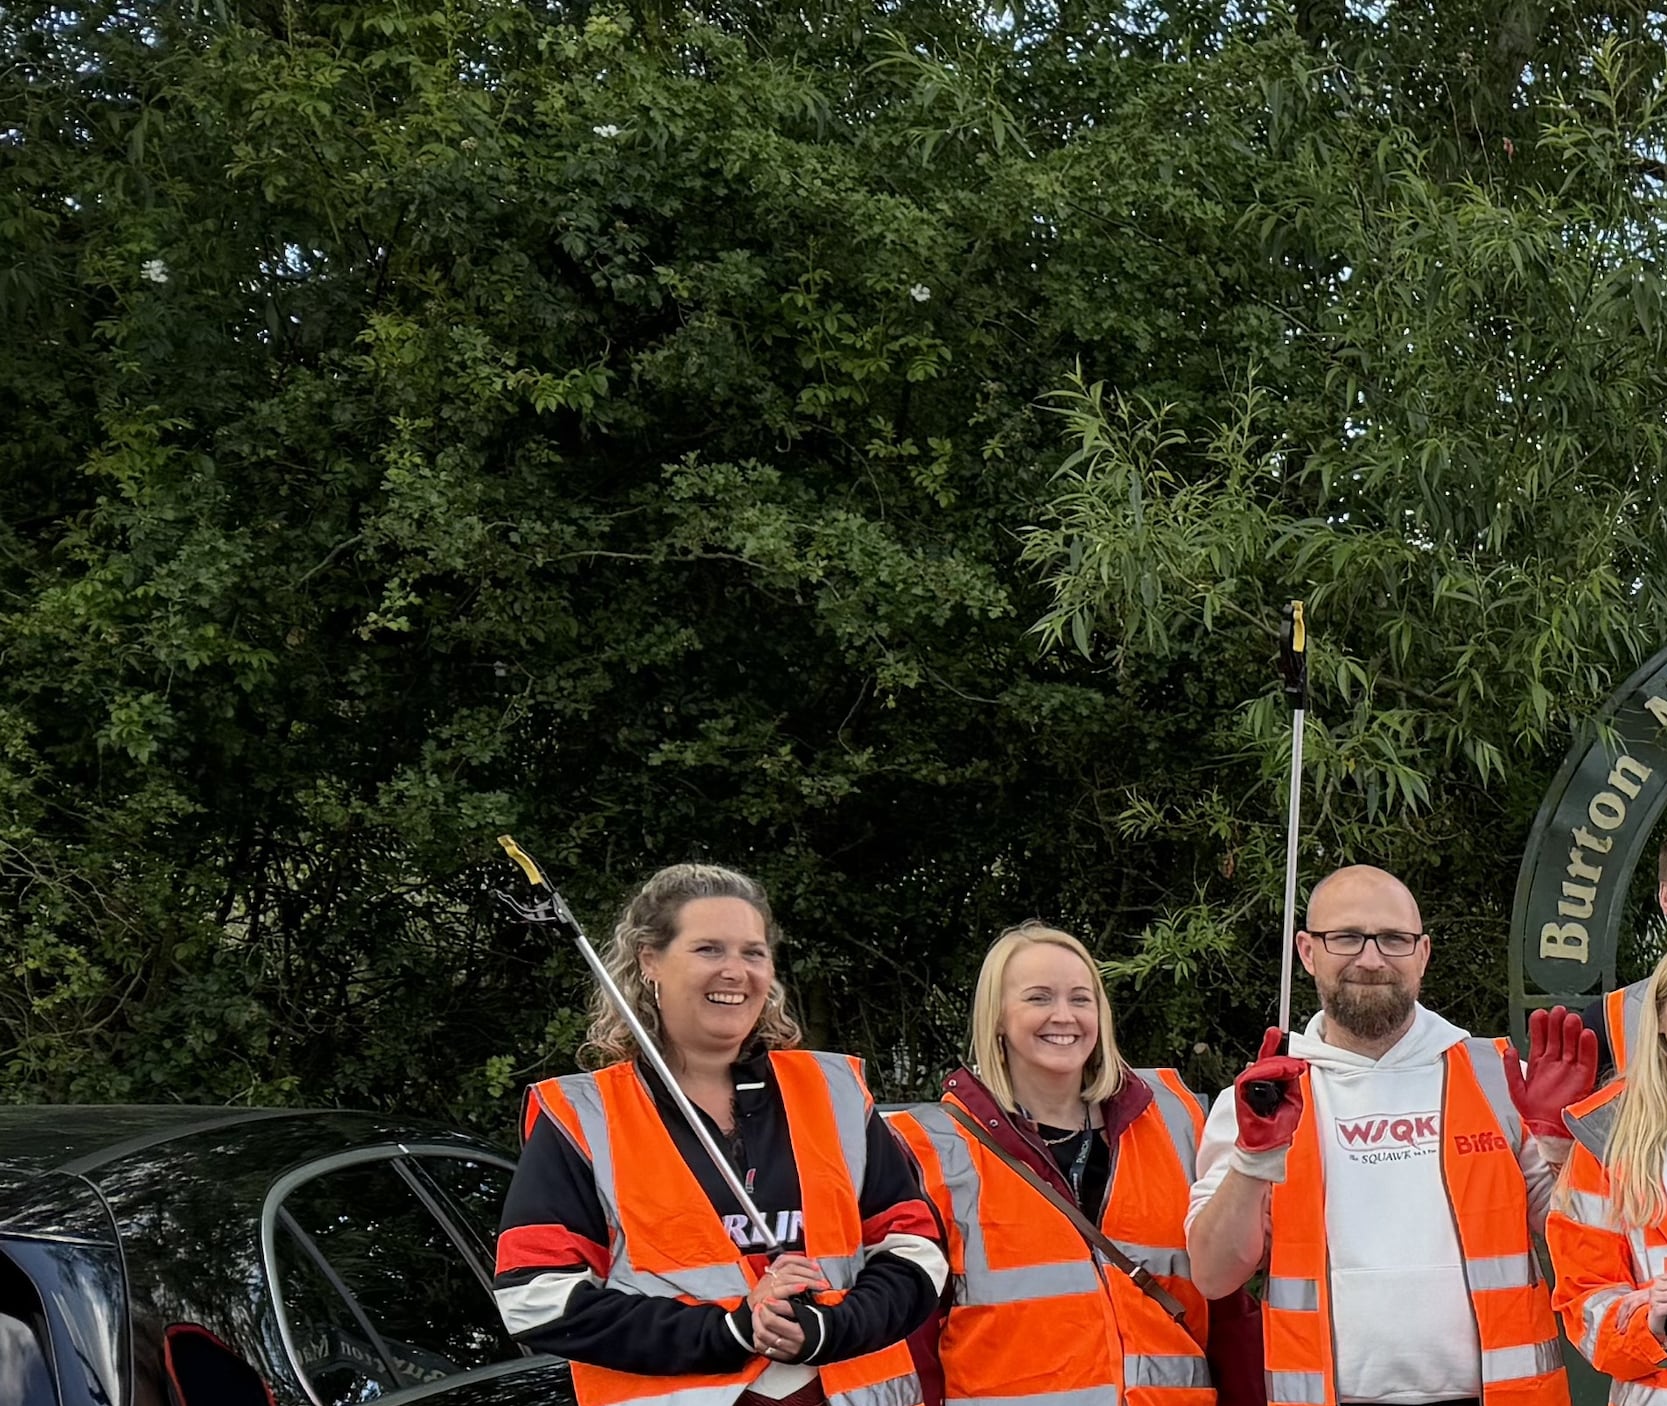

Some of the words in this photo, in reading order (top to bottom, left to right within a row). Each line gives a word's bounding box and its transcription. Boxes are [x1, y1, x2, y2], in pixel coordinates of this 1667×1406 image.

[1540, 755, 1653, 964] Burton
[1338, 1115, 1438, 1150] WSQK
[1454, 1132, 1508, 1155] Biffa
[1361, 1150, 1411, 1164] SQUAWK
